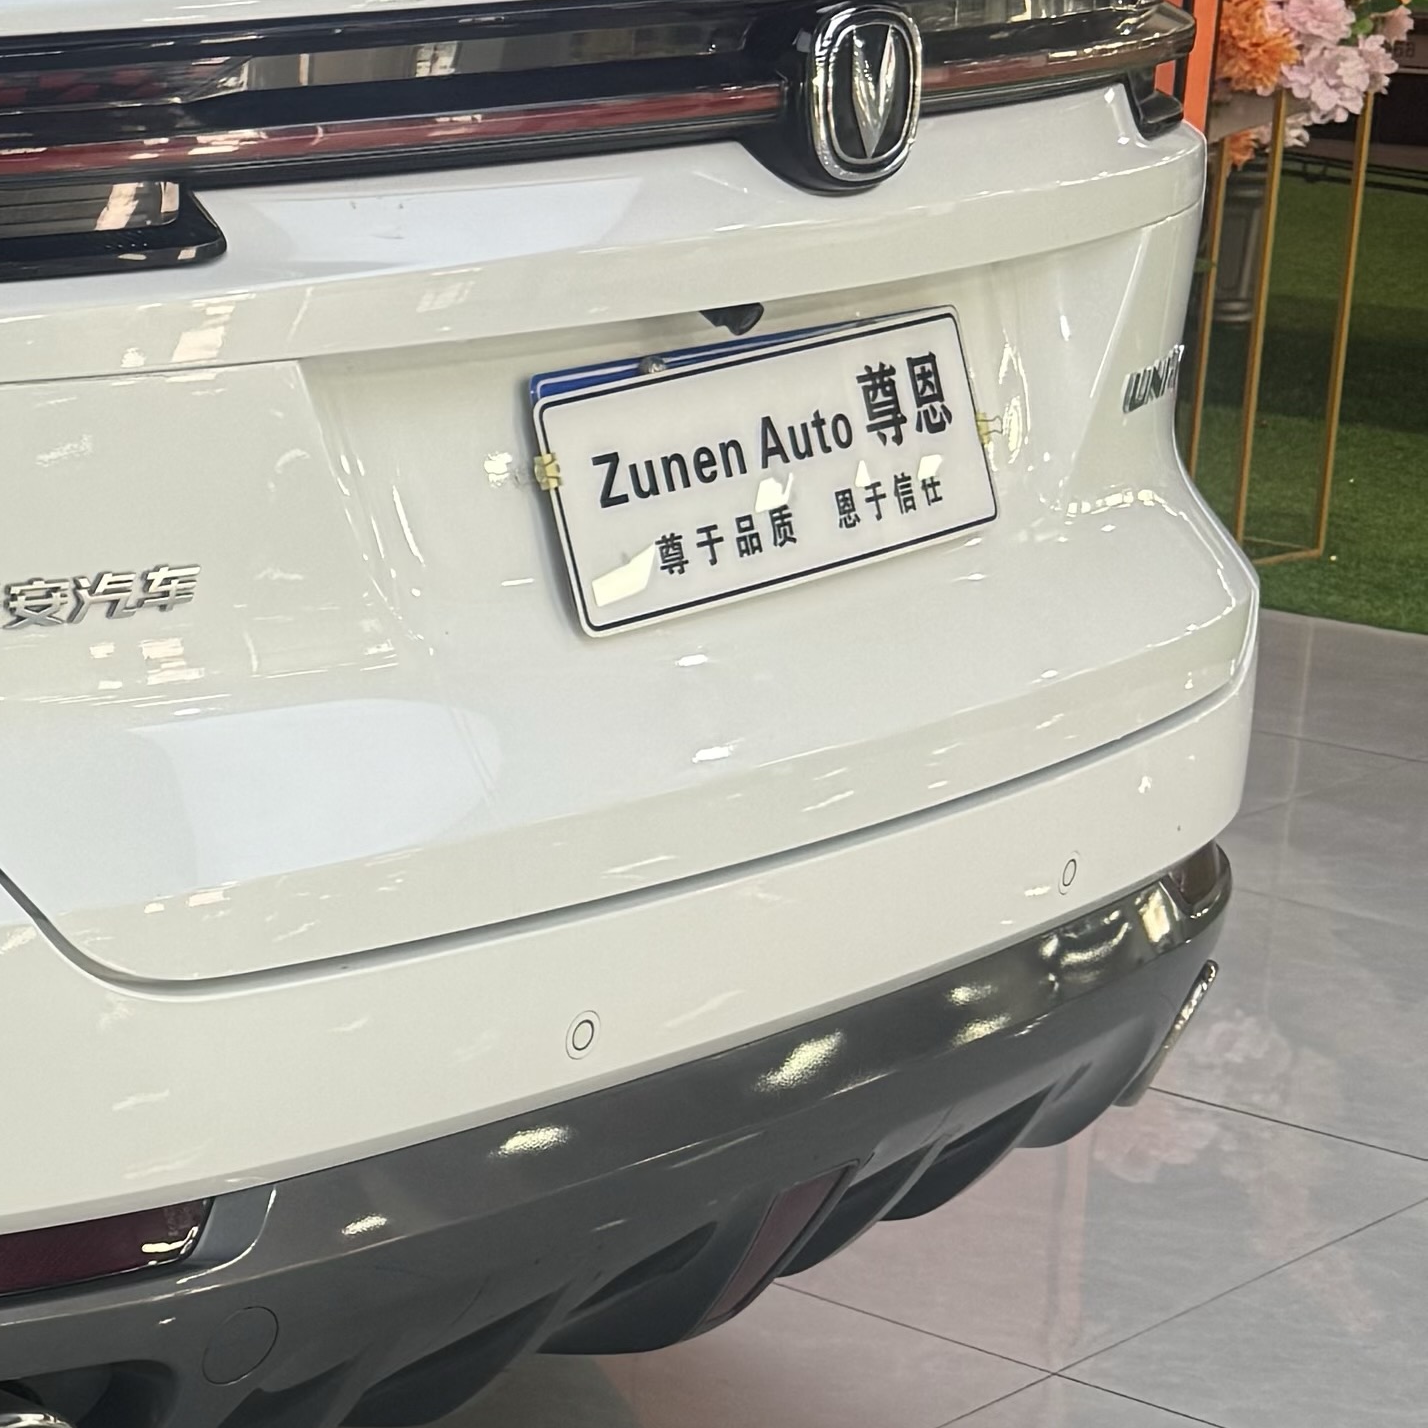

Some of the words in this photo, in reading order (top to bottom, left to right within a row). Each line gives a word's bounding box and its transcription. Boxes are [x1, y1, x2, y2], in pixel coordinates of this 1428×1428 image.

[591, 436, 750, 510] Zunen
[759, 408, 855, 470] Auto
[855, 352, 955, 448] 尊恩
[654, 503, 798, 577] 尊于品质
